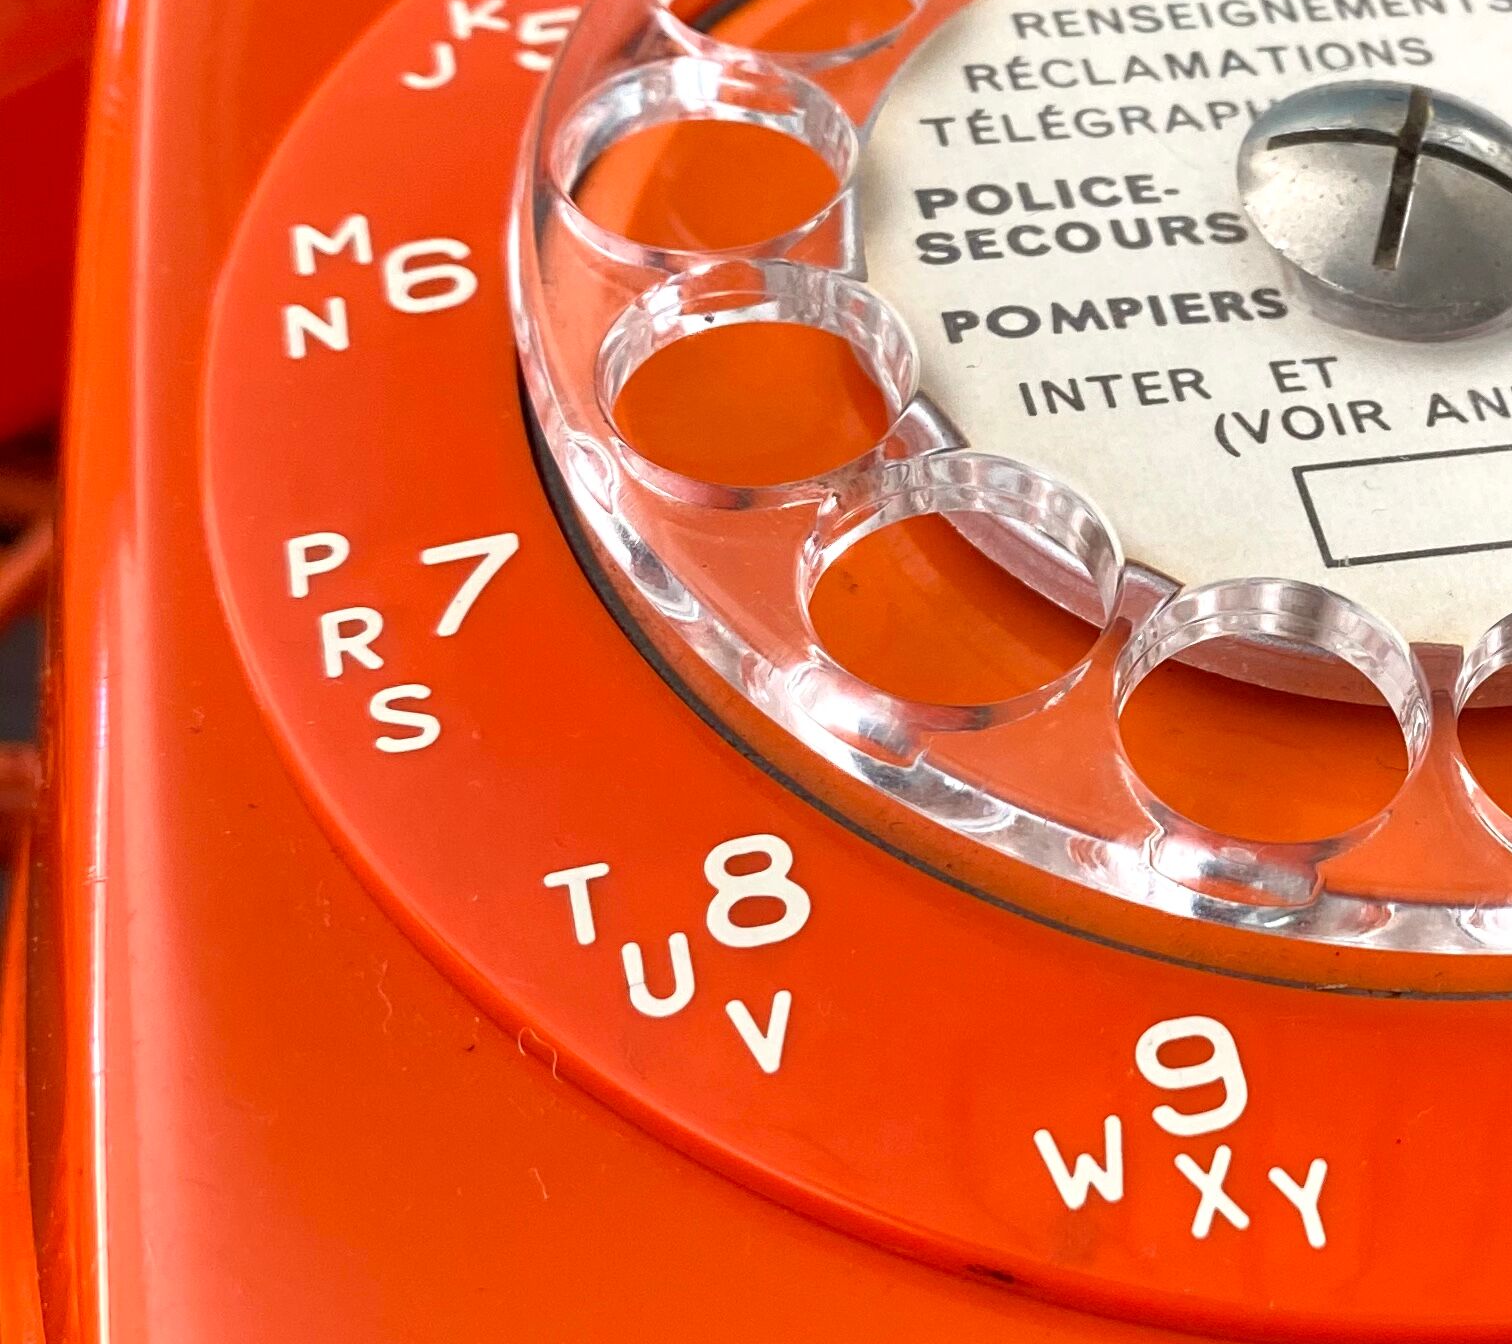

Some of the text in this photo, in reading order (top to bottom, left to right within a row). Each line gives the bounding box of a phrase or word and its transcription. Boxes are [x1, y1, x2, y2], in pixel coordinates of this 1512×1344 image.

[516, 5, 583, 72] 5
[962, 36, 1435, 94] RÉCLAMATIONS
[912, 173, 1181, 221] POLICE-
[914, 211, 1252, 266] SECOURS
[382, 238, 478, 314] 6
[940, 286, 1289, 345] POMPIERS
[1018, 367, 1213, 418] INTER
[1267, 355, 1339, 394] ET
[1213, 399, 1392, 459] (VOIR
[420, 532, 519, 637] 7
[703, 834, 811, 948] 8
[1135, 1015, 1248, 1137] 9
